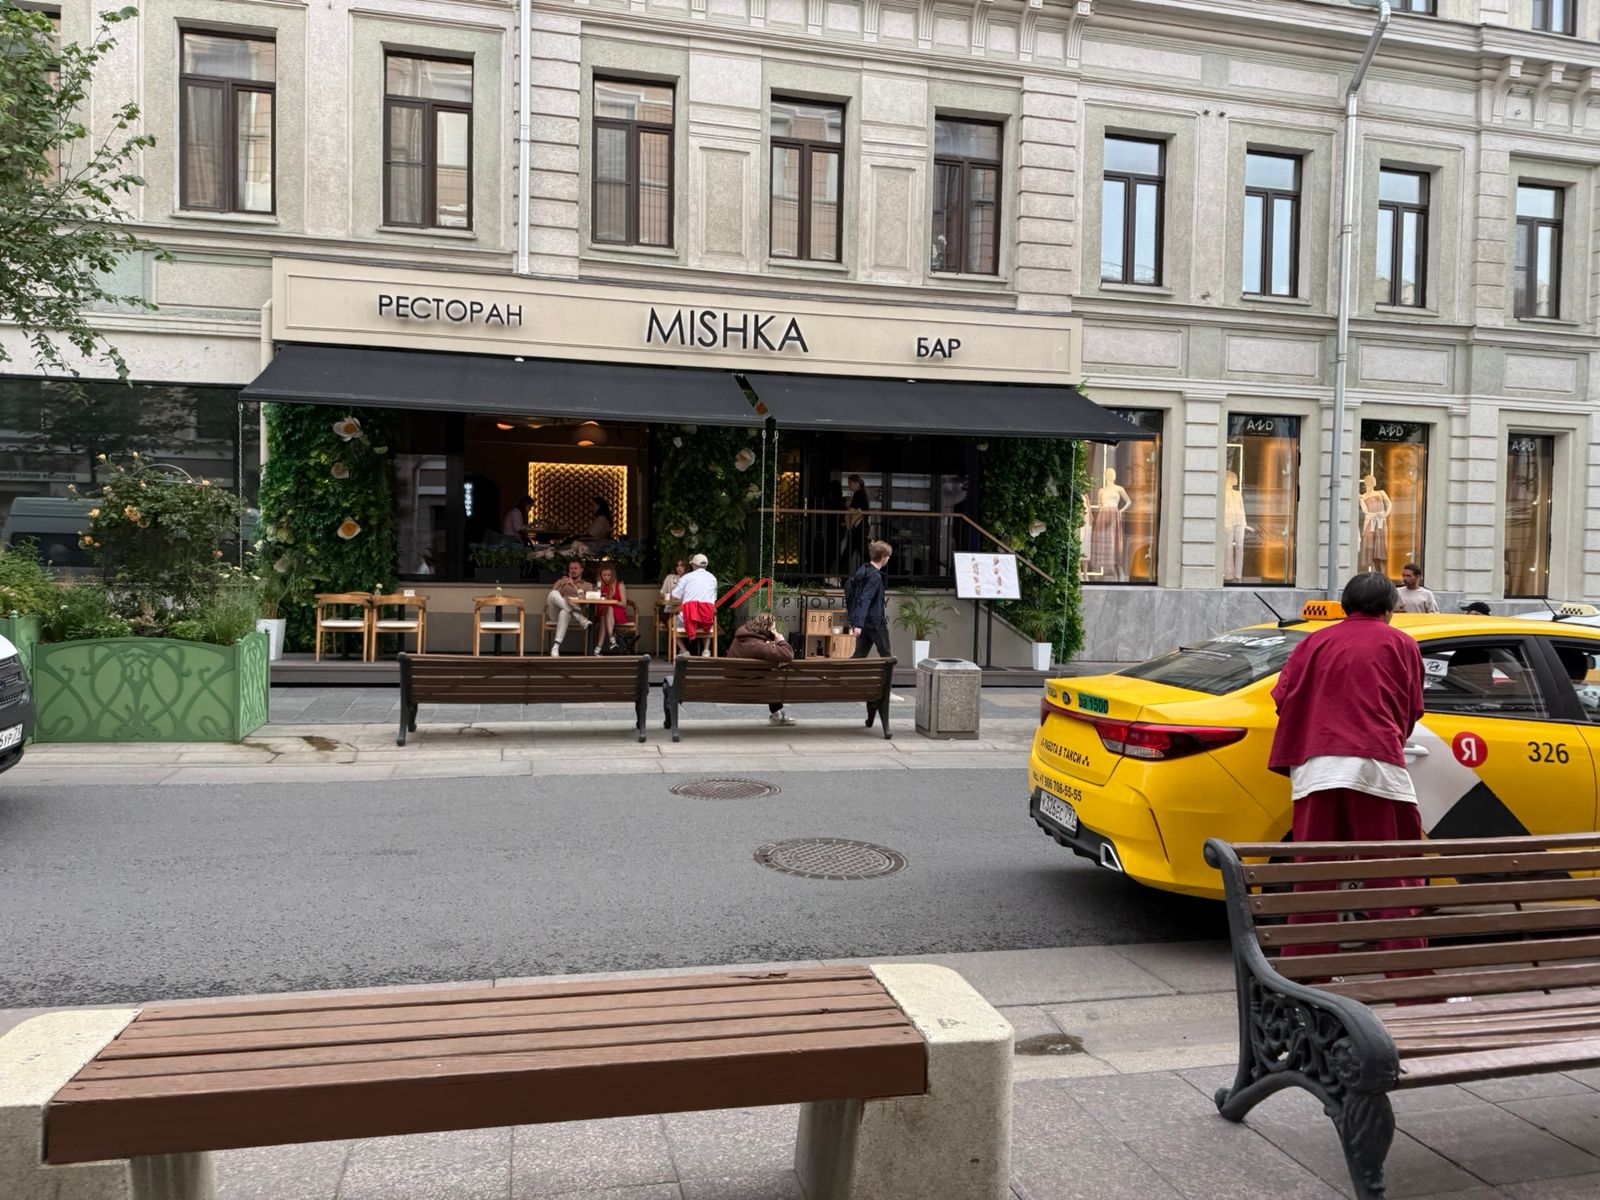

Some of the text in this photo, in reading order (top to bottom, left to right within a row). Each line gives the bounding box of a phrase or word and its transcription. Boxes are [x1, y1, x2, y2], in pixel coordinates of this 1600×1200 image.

[378, 295, 523, 327] РЕСТОРАН
[647, 305, 808, 354] MISHKA
[916, 338, 961, 359] БАР
[1063, 748, 1082, 765] ТАКСИ
[1460, 737, 1477, 761] Я
[1527, 741, 1569, 764] 326
